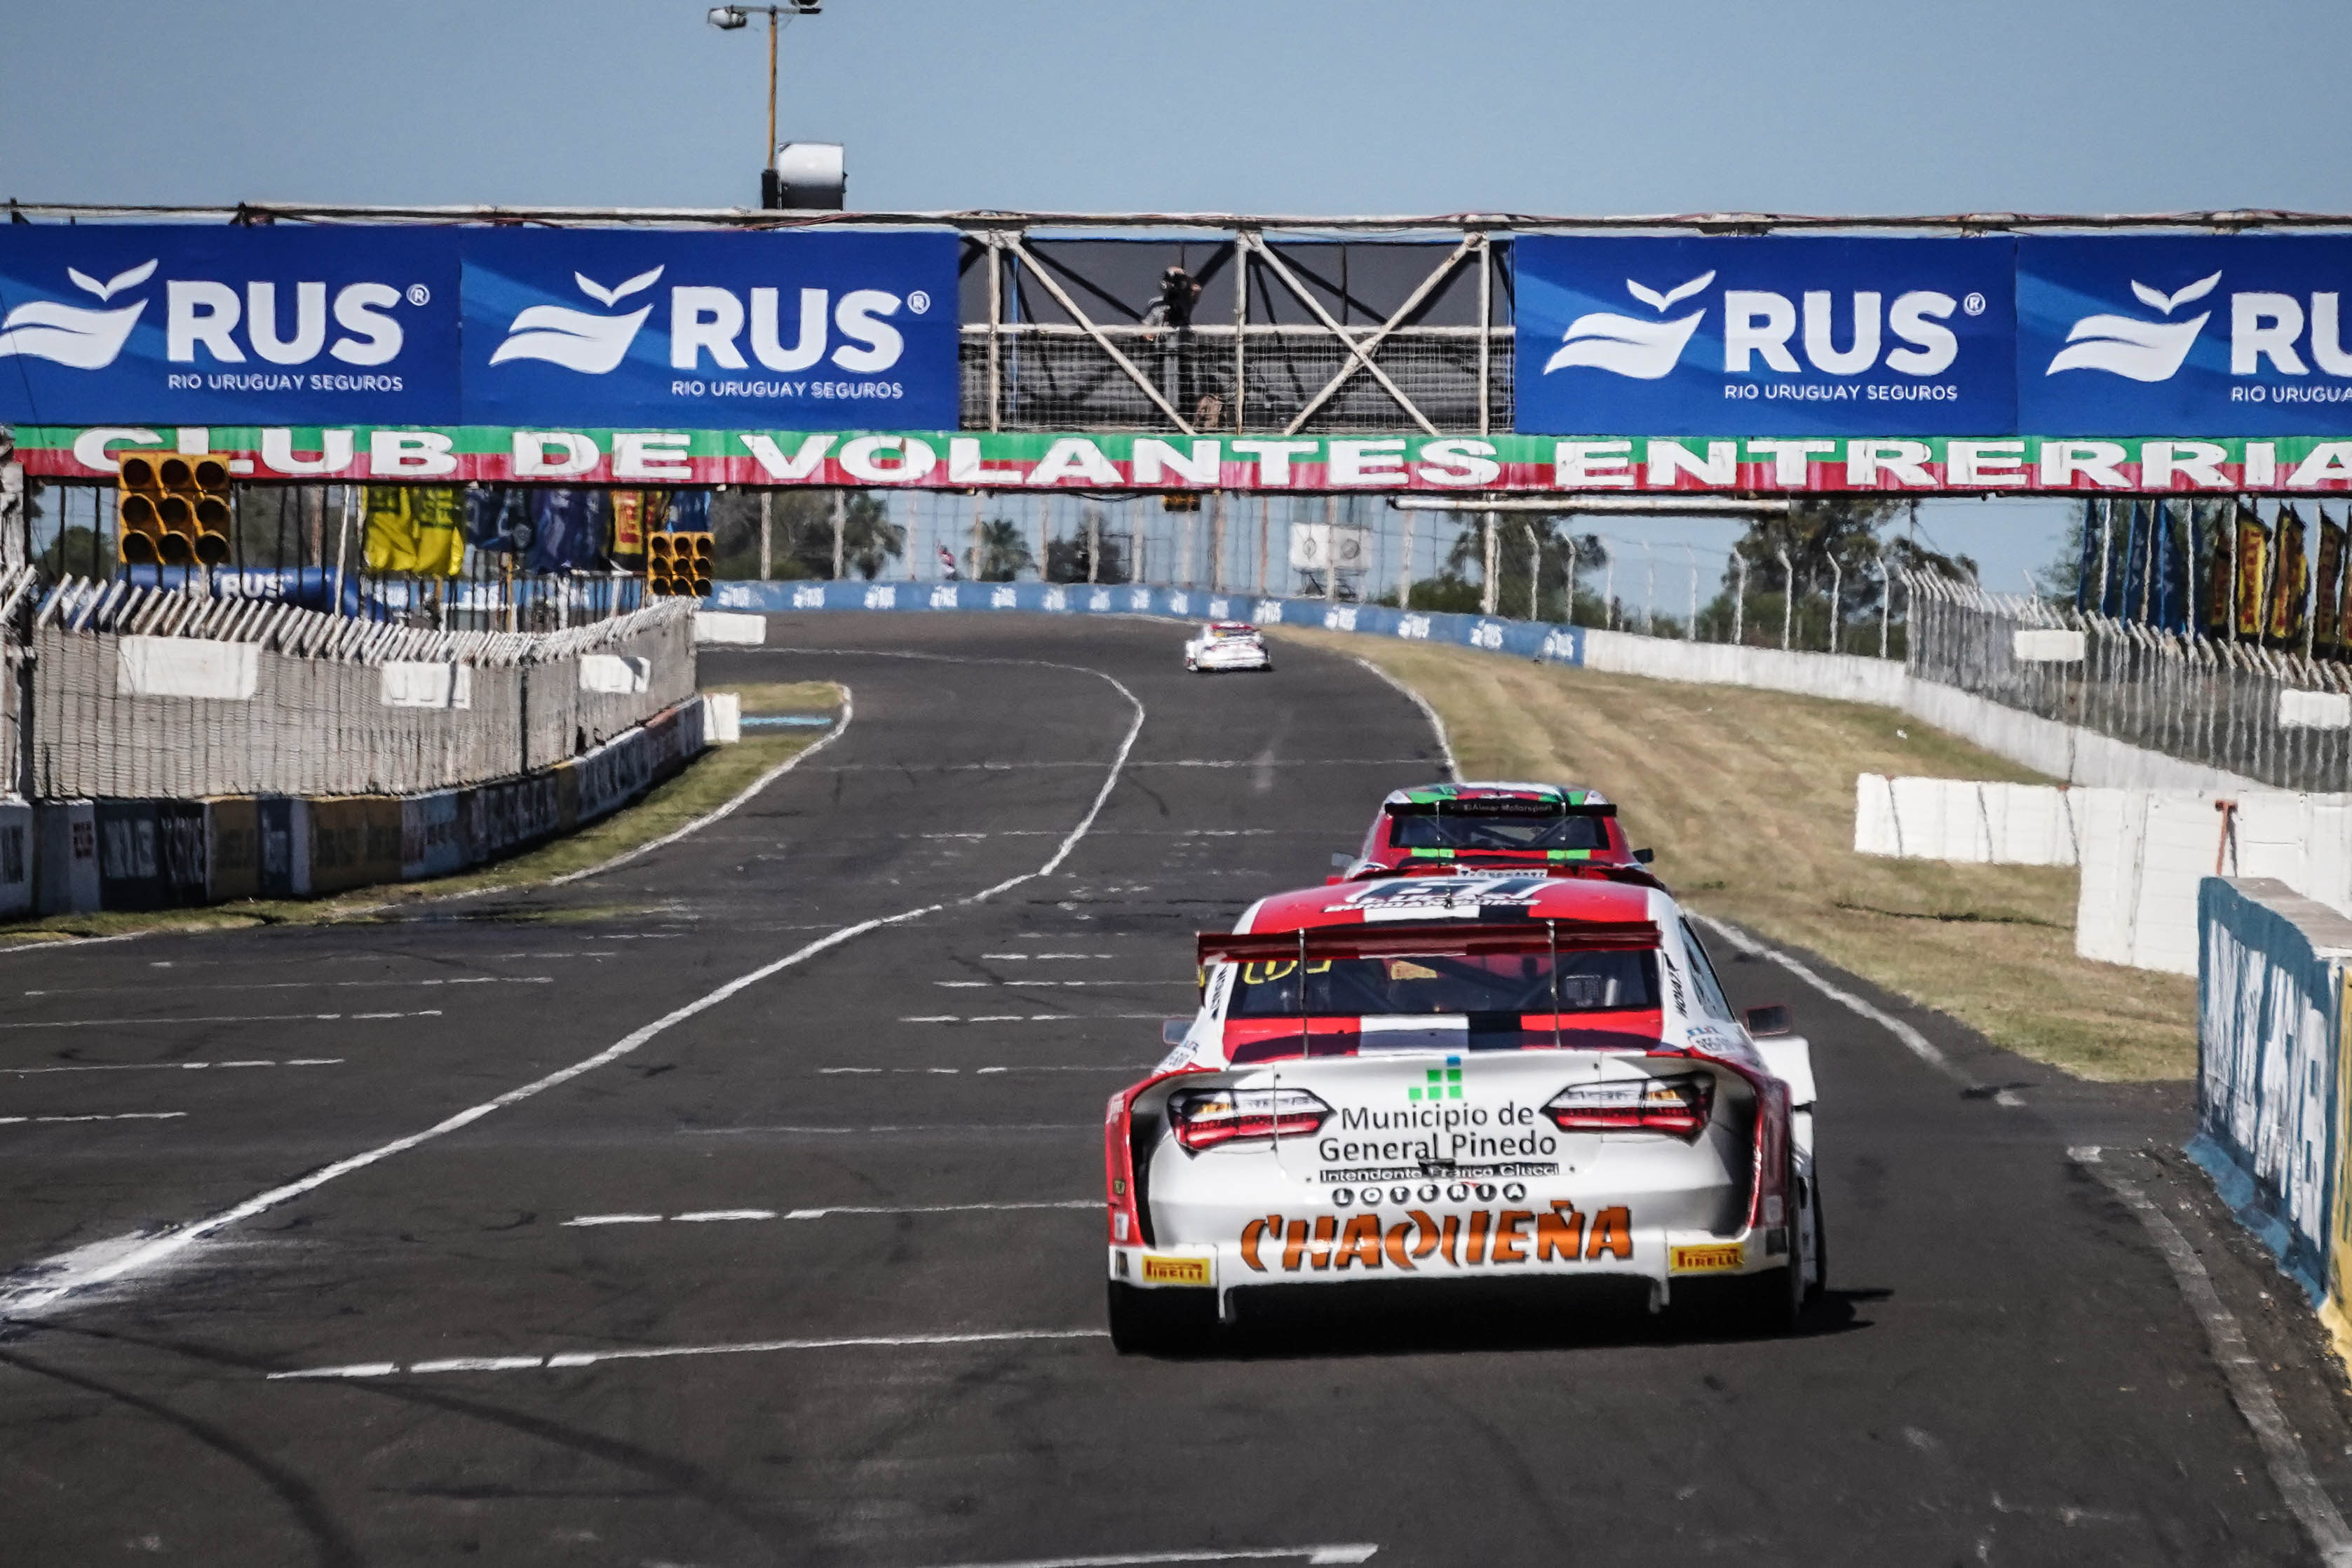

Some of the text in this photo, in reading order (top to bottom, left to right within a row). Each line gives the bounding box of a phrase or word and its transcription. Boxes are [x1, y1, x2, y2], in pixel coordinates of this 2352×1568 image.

[167, 279, 405, 366] RUS
[670, 285, 905, 374] RUS
[1724, 289, 1959, 377] RUS
[168, 374, 403, 392] RIO URUGUAY SEGUROS
[672, 381, 903, 399] RIO URUGUAY SEGUROS
[1724, 384, 1958, 401] RIO URUGUAY SEGUROS
[2231, 386, 2266, 402] RIO
[74, 426, 458, 476] CLUB
[512, 431, 694, 480] DE
[739, 434, 1501, 485] VOLANTES
[1341, 1100, 1534, 1133] Municipio de
[1319, 1130, 1557, 1162] General Pinedo
[1322, 1168, 1423, 1182] Intendente
[1241, 1199, 1635, 1273] CHAQUEÑA
[1146, 1260, 1203, 1280] PIRELLI
[1677, 1248, 1739, 1268] PIRELLI
